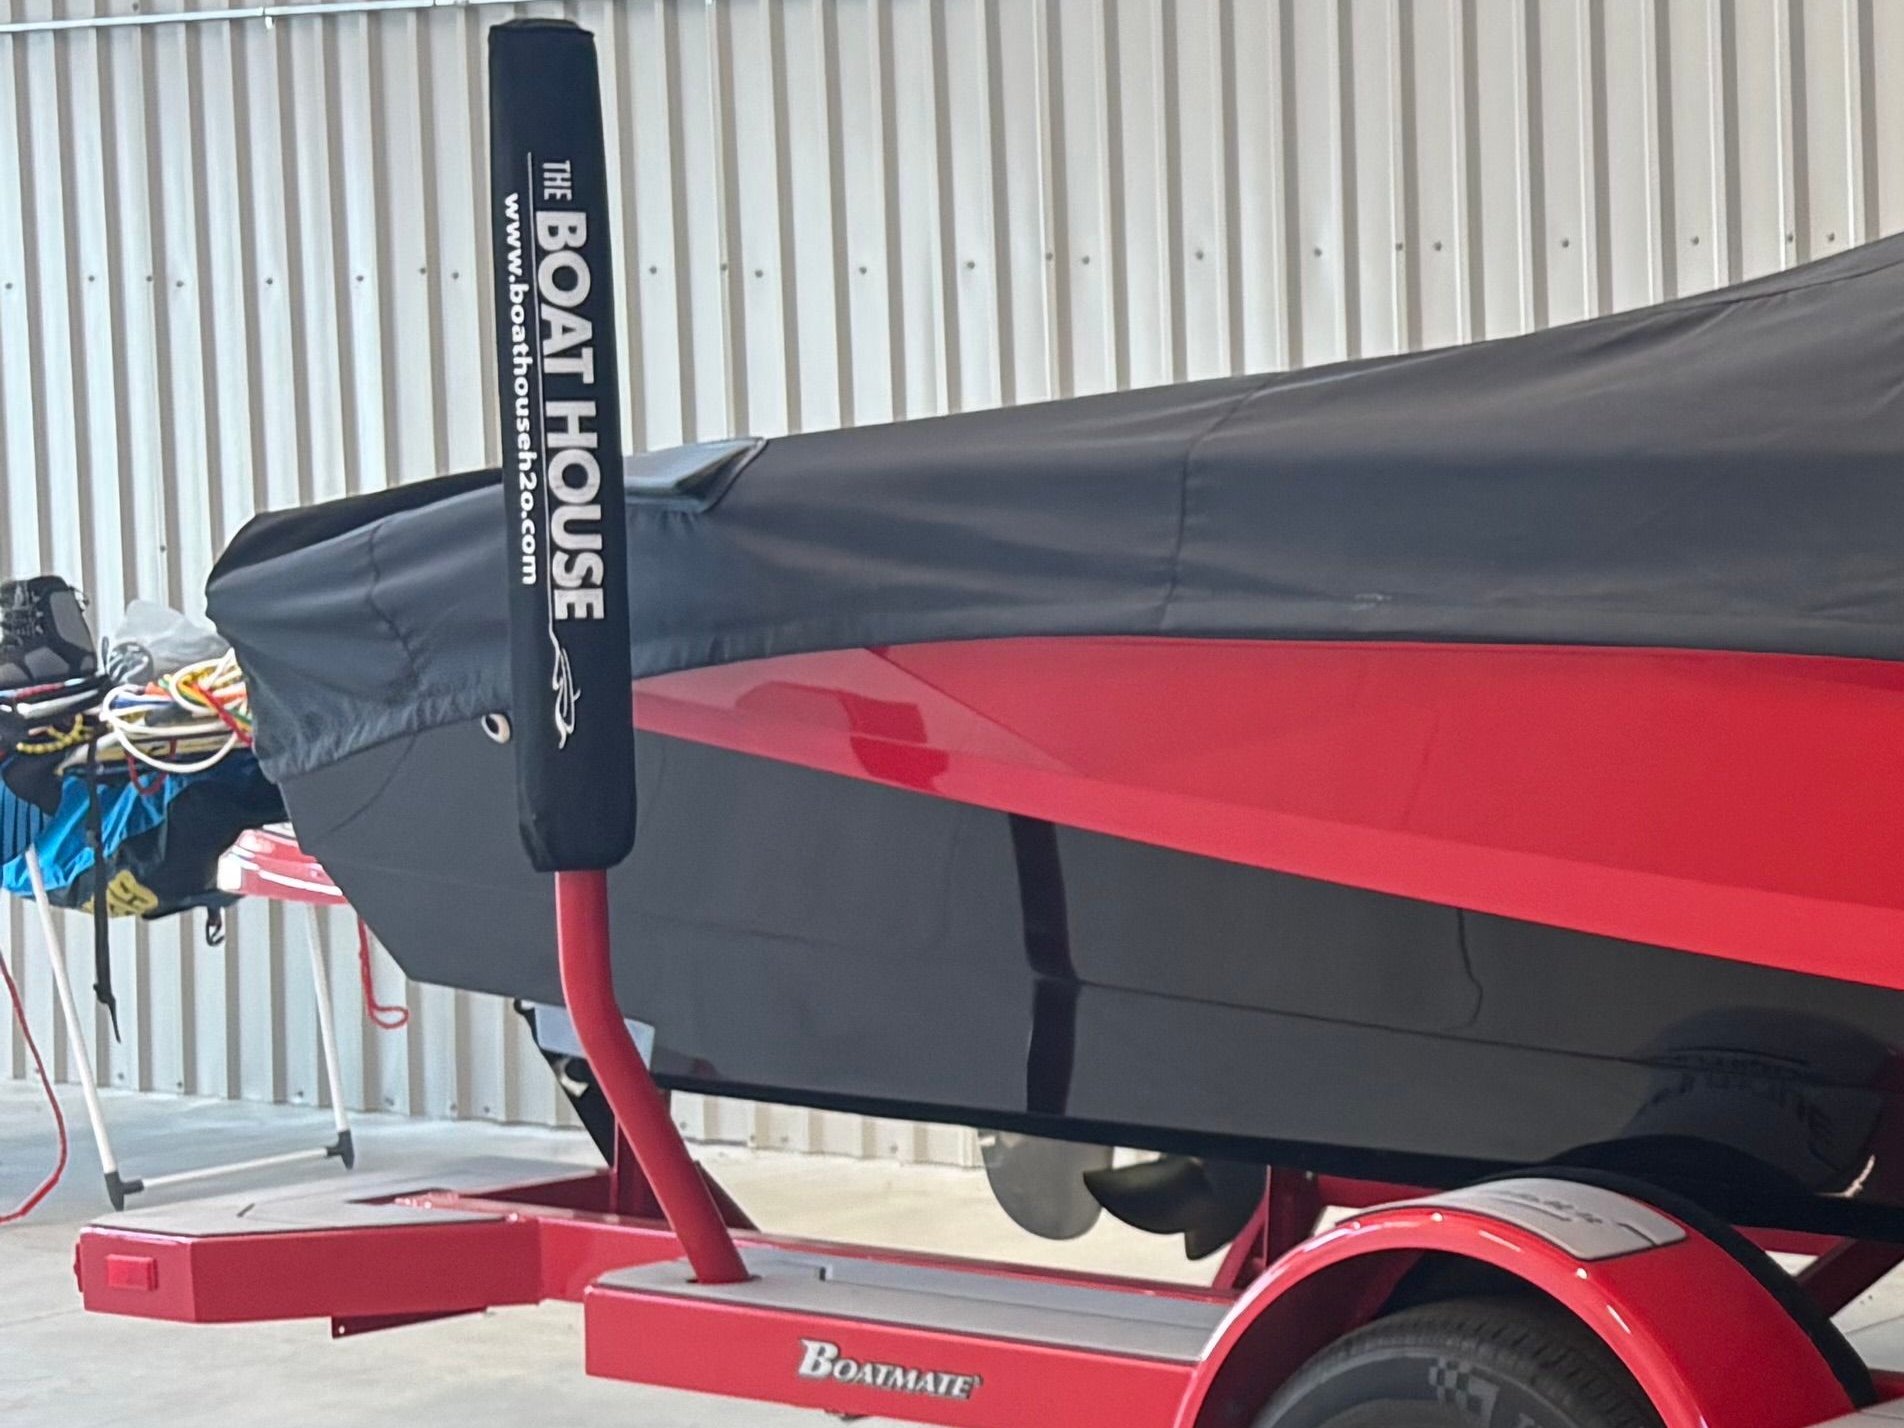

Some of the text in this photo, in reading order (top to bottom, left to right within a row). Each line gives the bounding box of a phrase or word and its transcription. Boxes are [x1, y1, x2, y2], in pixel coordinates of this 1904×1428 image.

[503, 191, 538, 587] www.boathouseh2o.com
[536, 159, 605, 621] THE BOAT HOUSE
